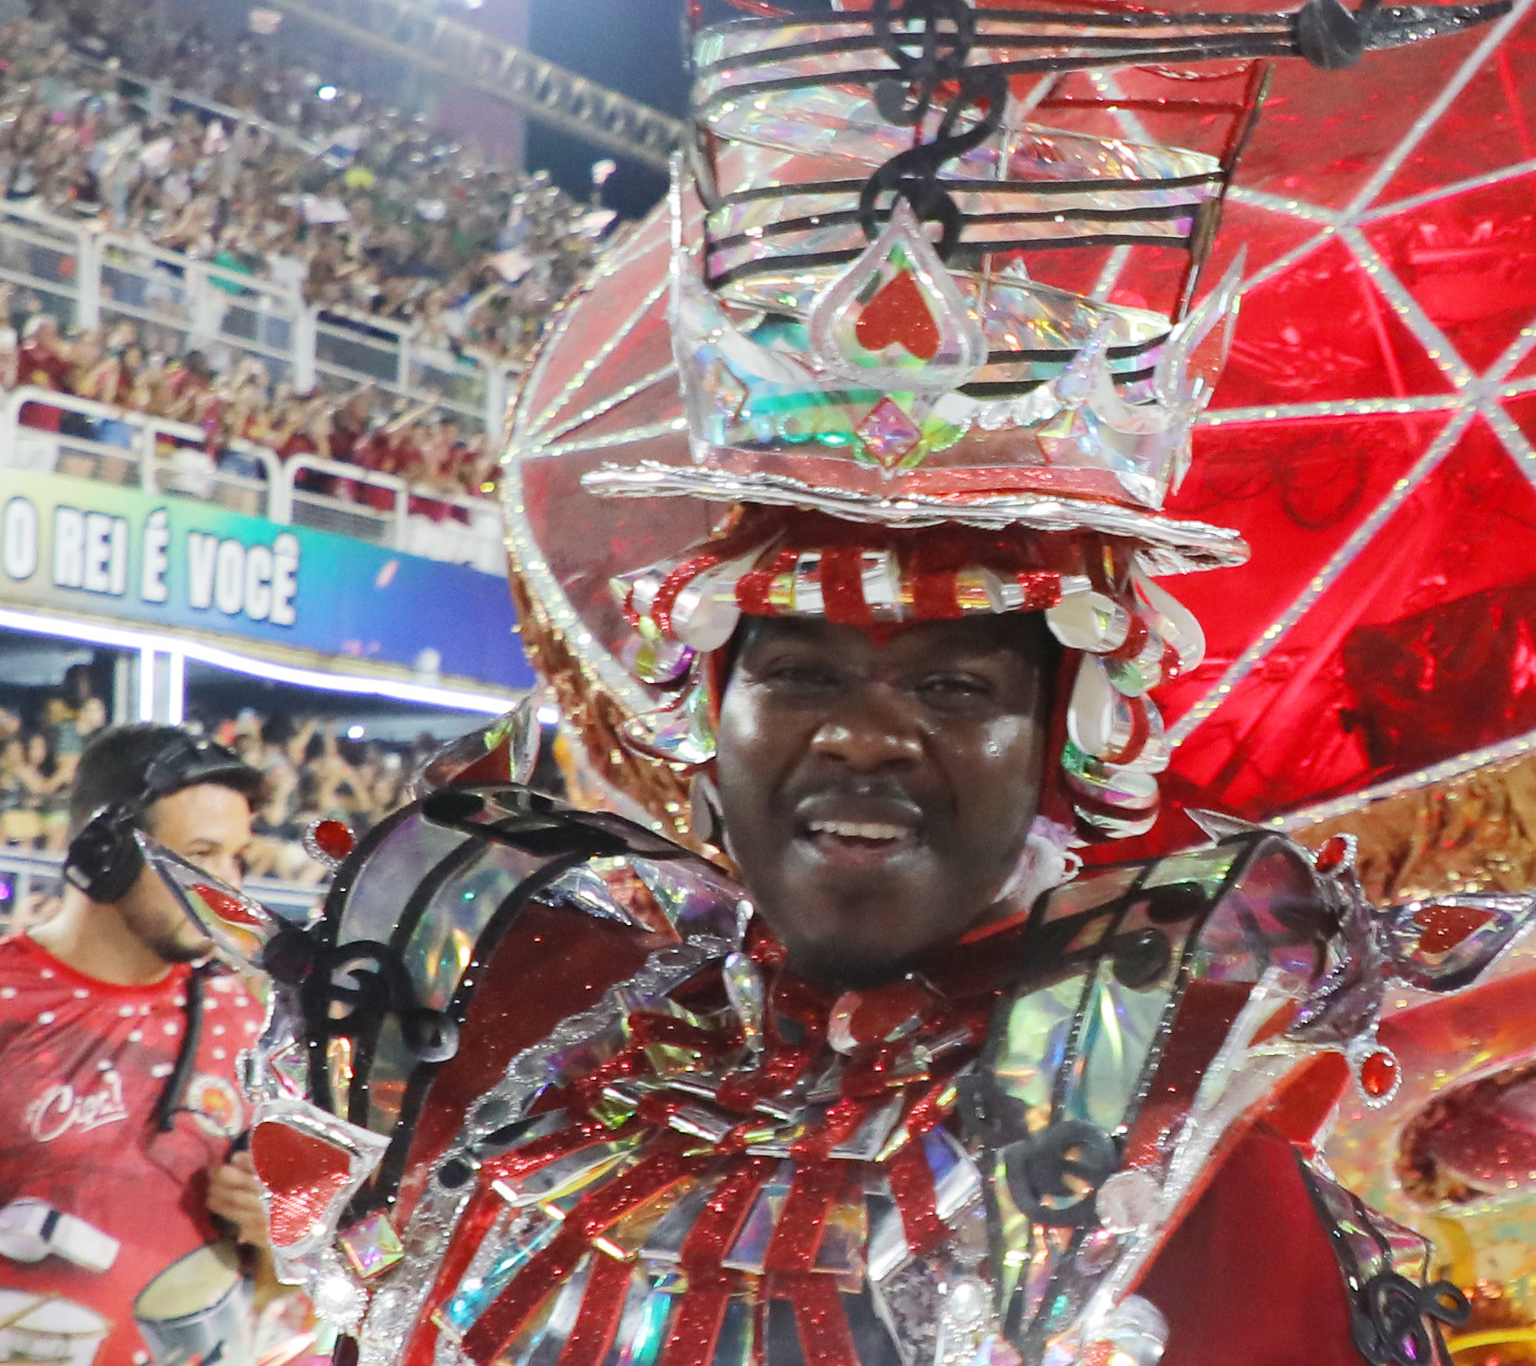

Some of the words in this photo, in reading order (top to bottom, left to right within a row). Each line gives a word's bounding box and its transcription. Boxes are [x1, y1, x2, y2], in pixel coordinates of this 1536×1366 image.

[2, 495, 39, 581] O
[54, 505, 129, 597] REI
[140, 505, 169, 604] É
[187, 530, 301, 627] VOCÊ
